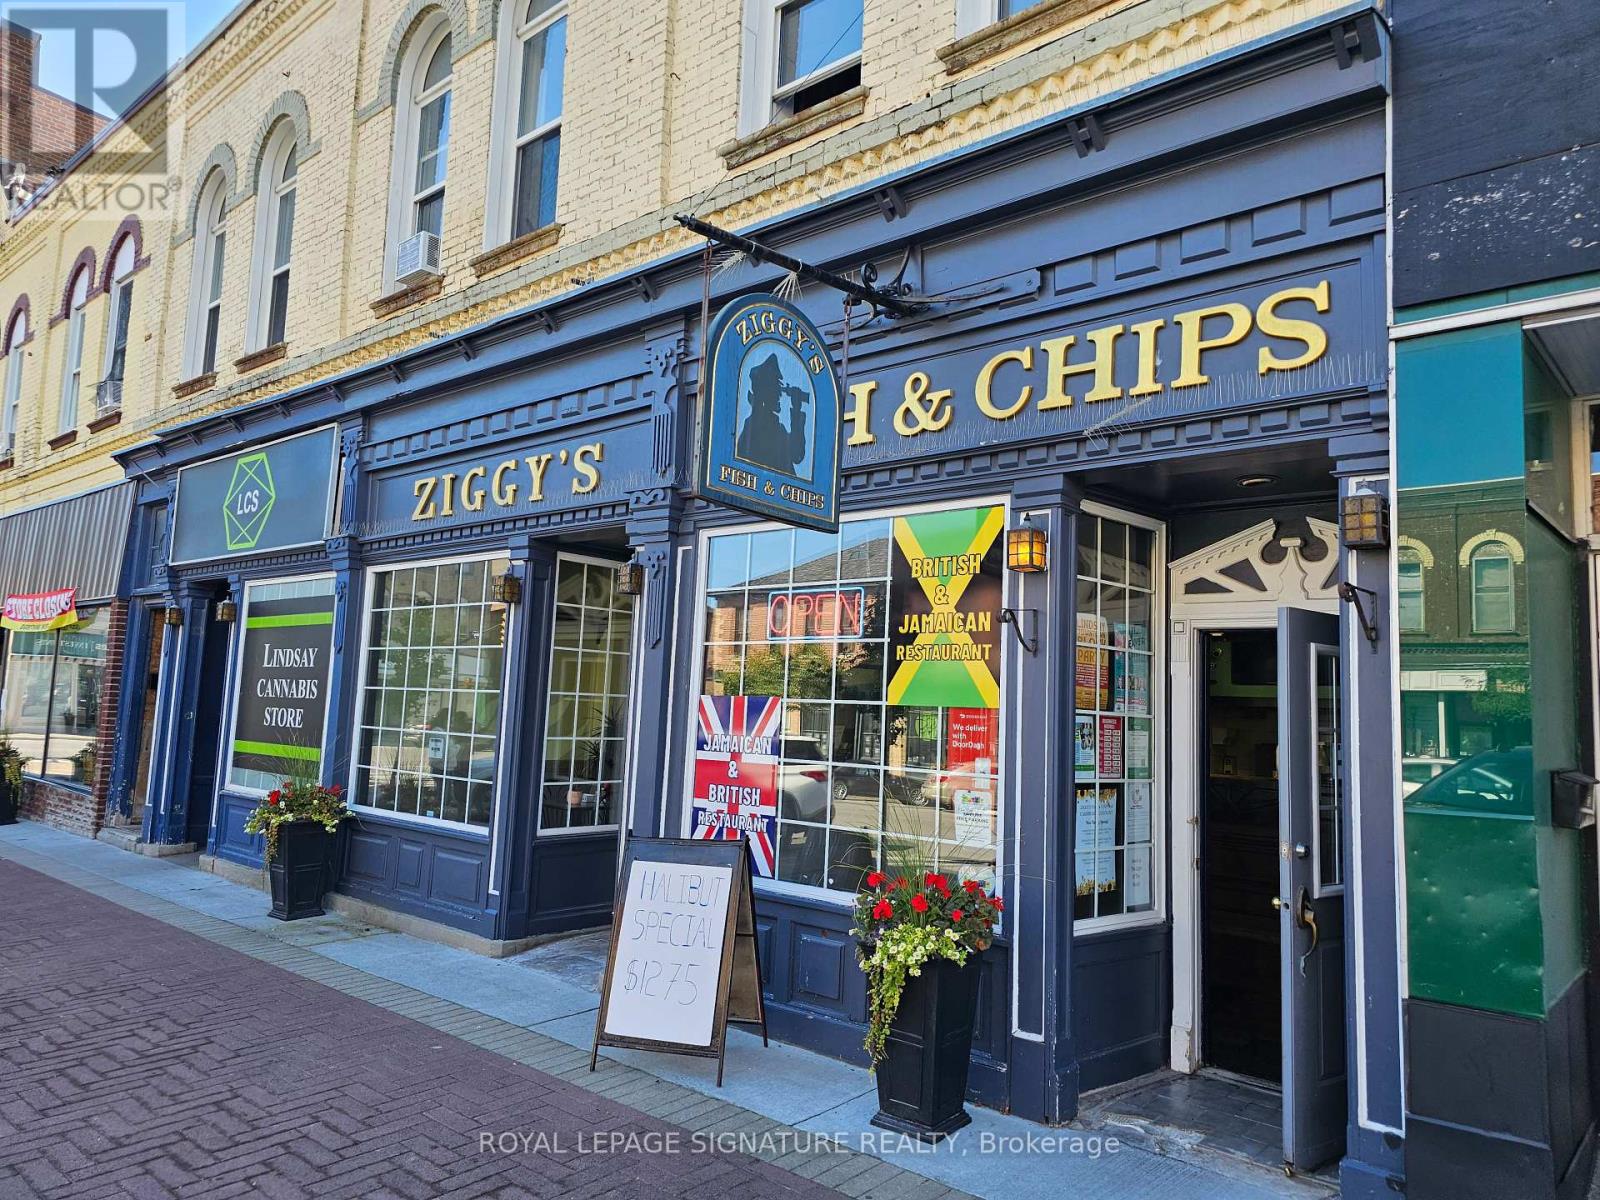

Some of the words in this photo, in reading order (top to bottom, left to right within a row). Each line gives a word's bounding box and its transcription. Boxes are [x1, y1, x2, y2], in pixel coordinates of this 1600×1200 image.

[735, 310, 825, 376] ZIGGY'S
[893, 371, 952, 437] &
[975, 279, 1331, 421] CHIPS
[411, 442, 604, 521] ZIGGY'S
[719, 464, 758, 492] FISH
[763, 480, 775, 496] &
[780, 483, 825, 510] CHIPS
[236, 488, 260, 516] LCS
[911, 553, 982, 579] BRITISH
[933, 584, 949, 605] &
[769, 593, 862, 636] OPEN
[898, 611, 992, 634] JAMAICAN
[262, 642, 319, 668] LINDSAY
[896, 643, 993, 661] RESTAURANT
[1077, 649, 1105, 663] PARY
[256, 678, 319, 700] CANNABIS
[263, 706, 304, 729] STORE
[952, 723, 964, 731] We
[965, 724, 987, 732] deliver
[703, 733, 772, 755] JAMAICAN
[727, 760, 738, 778] &
[708, 784, 761, 807] BRITISH
[697, 810, 769, 833] RESTAURANT
[640, 870, 725, 907] HALIBUT
[632, 909, 716, 949] SPECIAL
